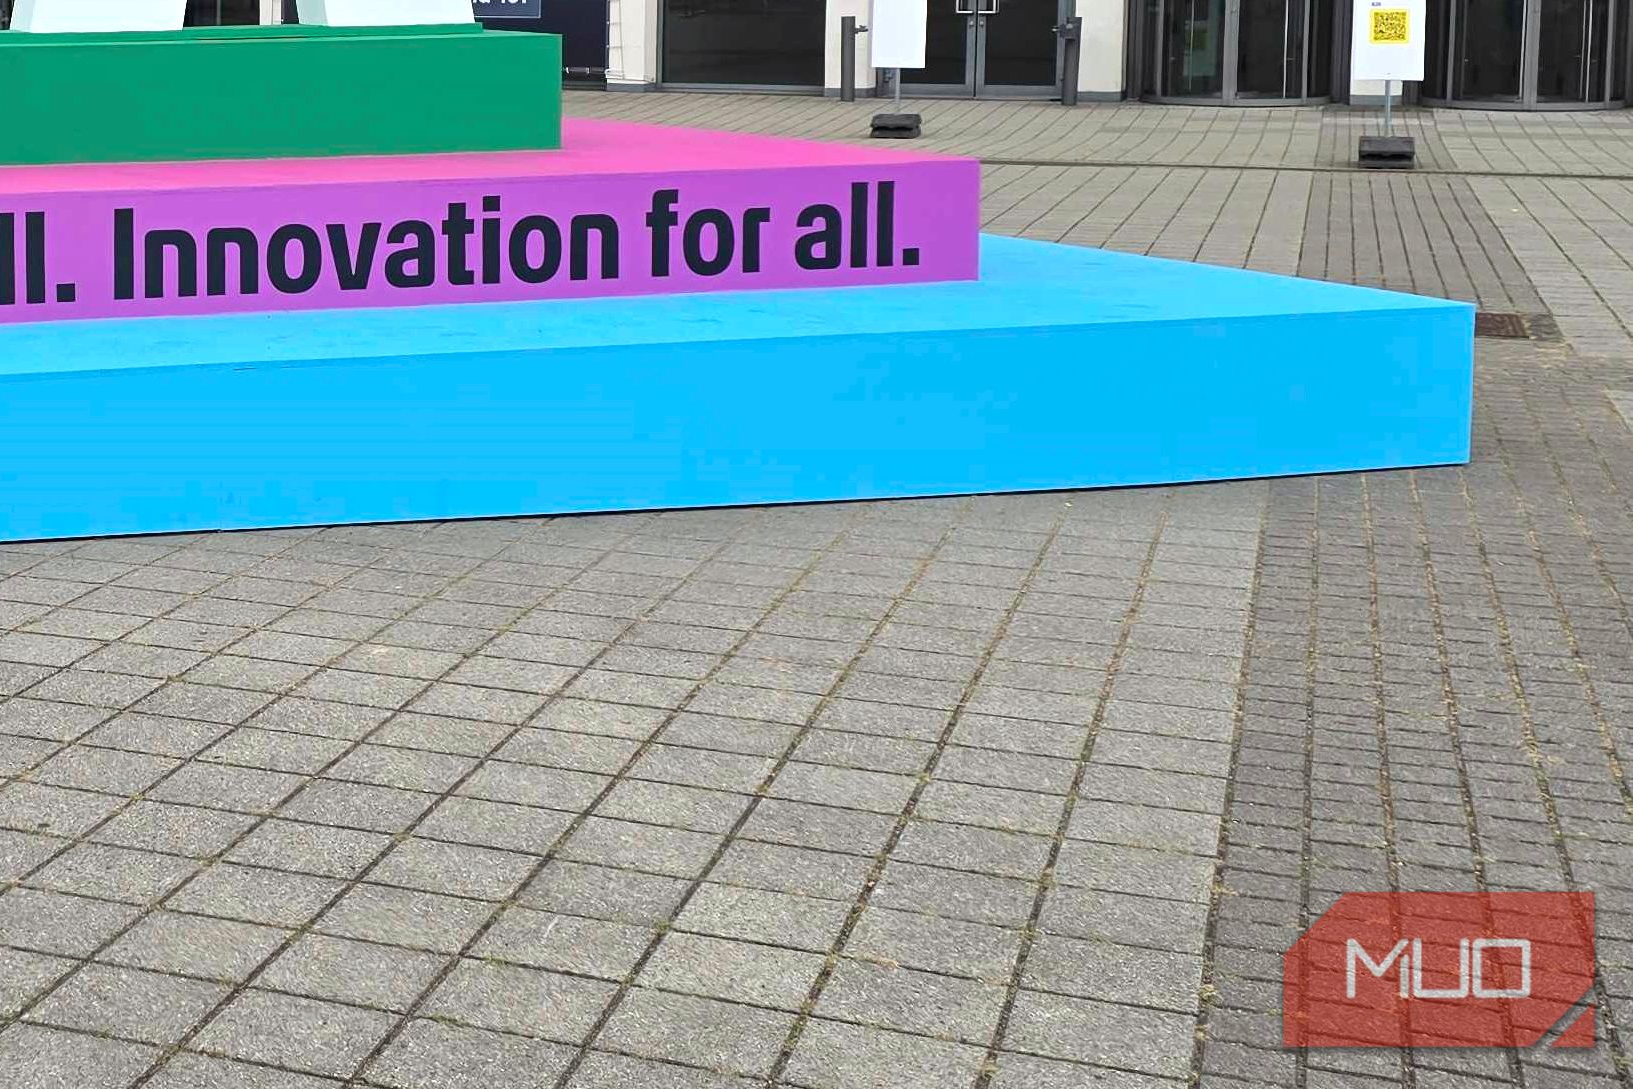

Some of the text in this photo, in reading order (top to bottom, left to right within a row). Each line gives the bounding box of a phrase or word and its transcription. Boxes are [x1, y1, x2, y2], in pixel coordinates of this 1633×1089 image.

[113, 195, 620, 301] Innovation
[646, 189, 770, 279] for
[794, 181, 920, 271] all.
